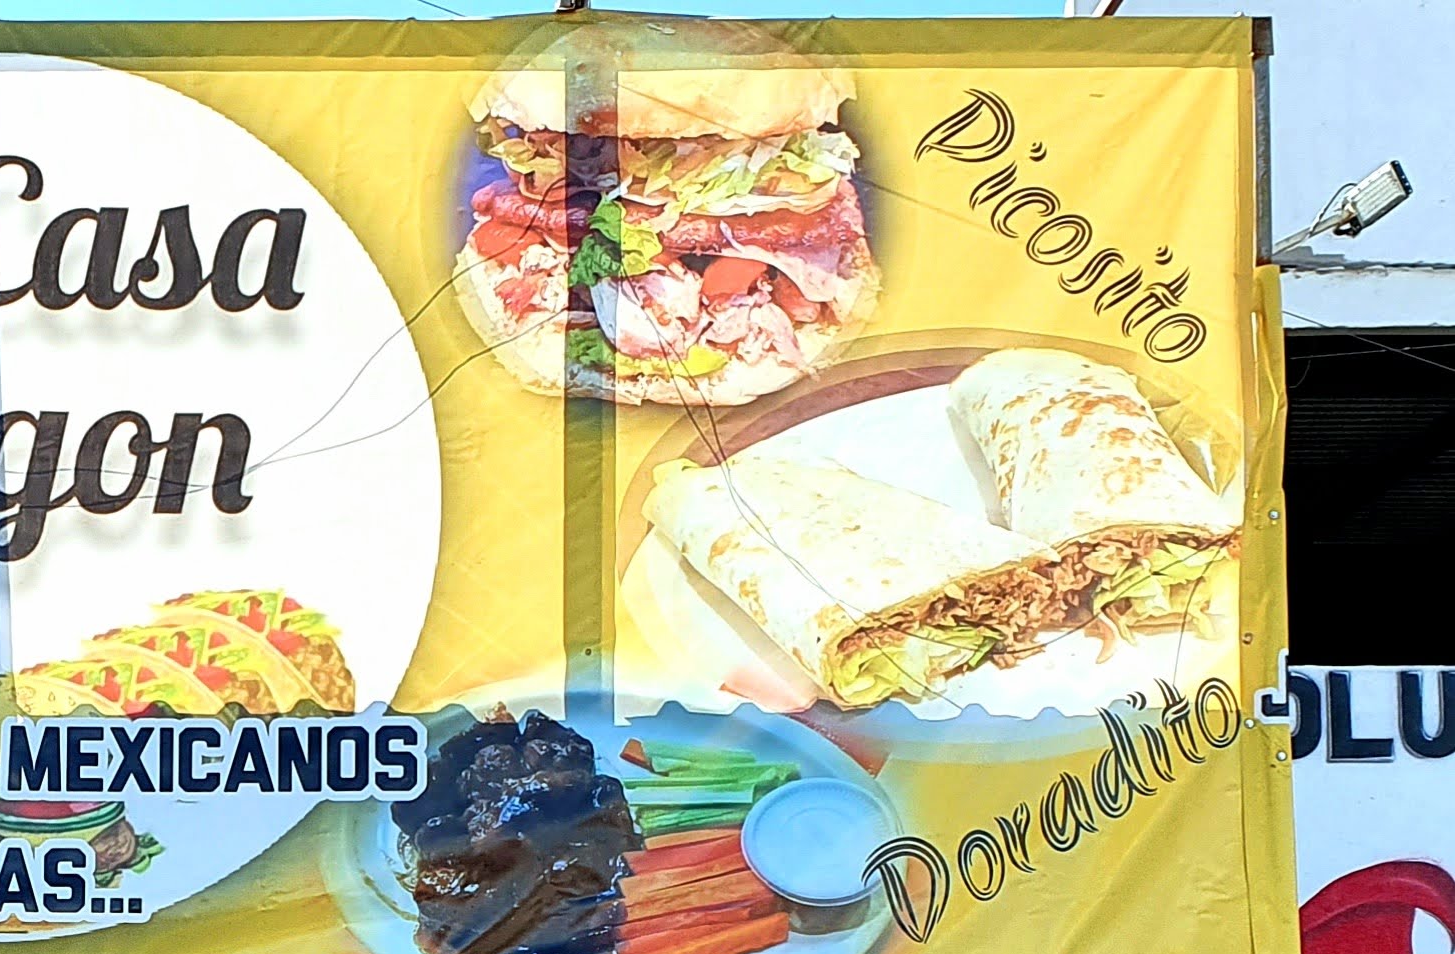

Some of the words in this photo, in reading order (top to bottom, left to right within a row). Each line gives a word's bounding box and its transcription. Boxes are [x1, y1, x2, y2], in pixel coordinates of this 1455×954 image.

[914, 88, 1206, 363] Picosito
[6, 725, 418, 794] MEXICANOS
[860, 676, 1240, 944] Doradito
